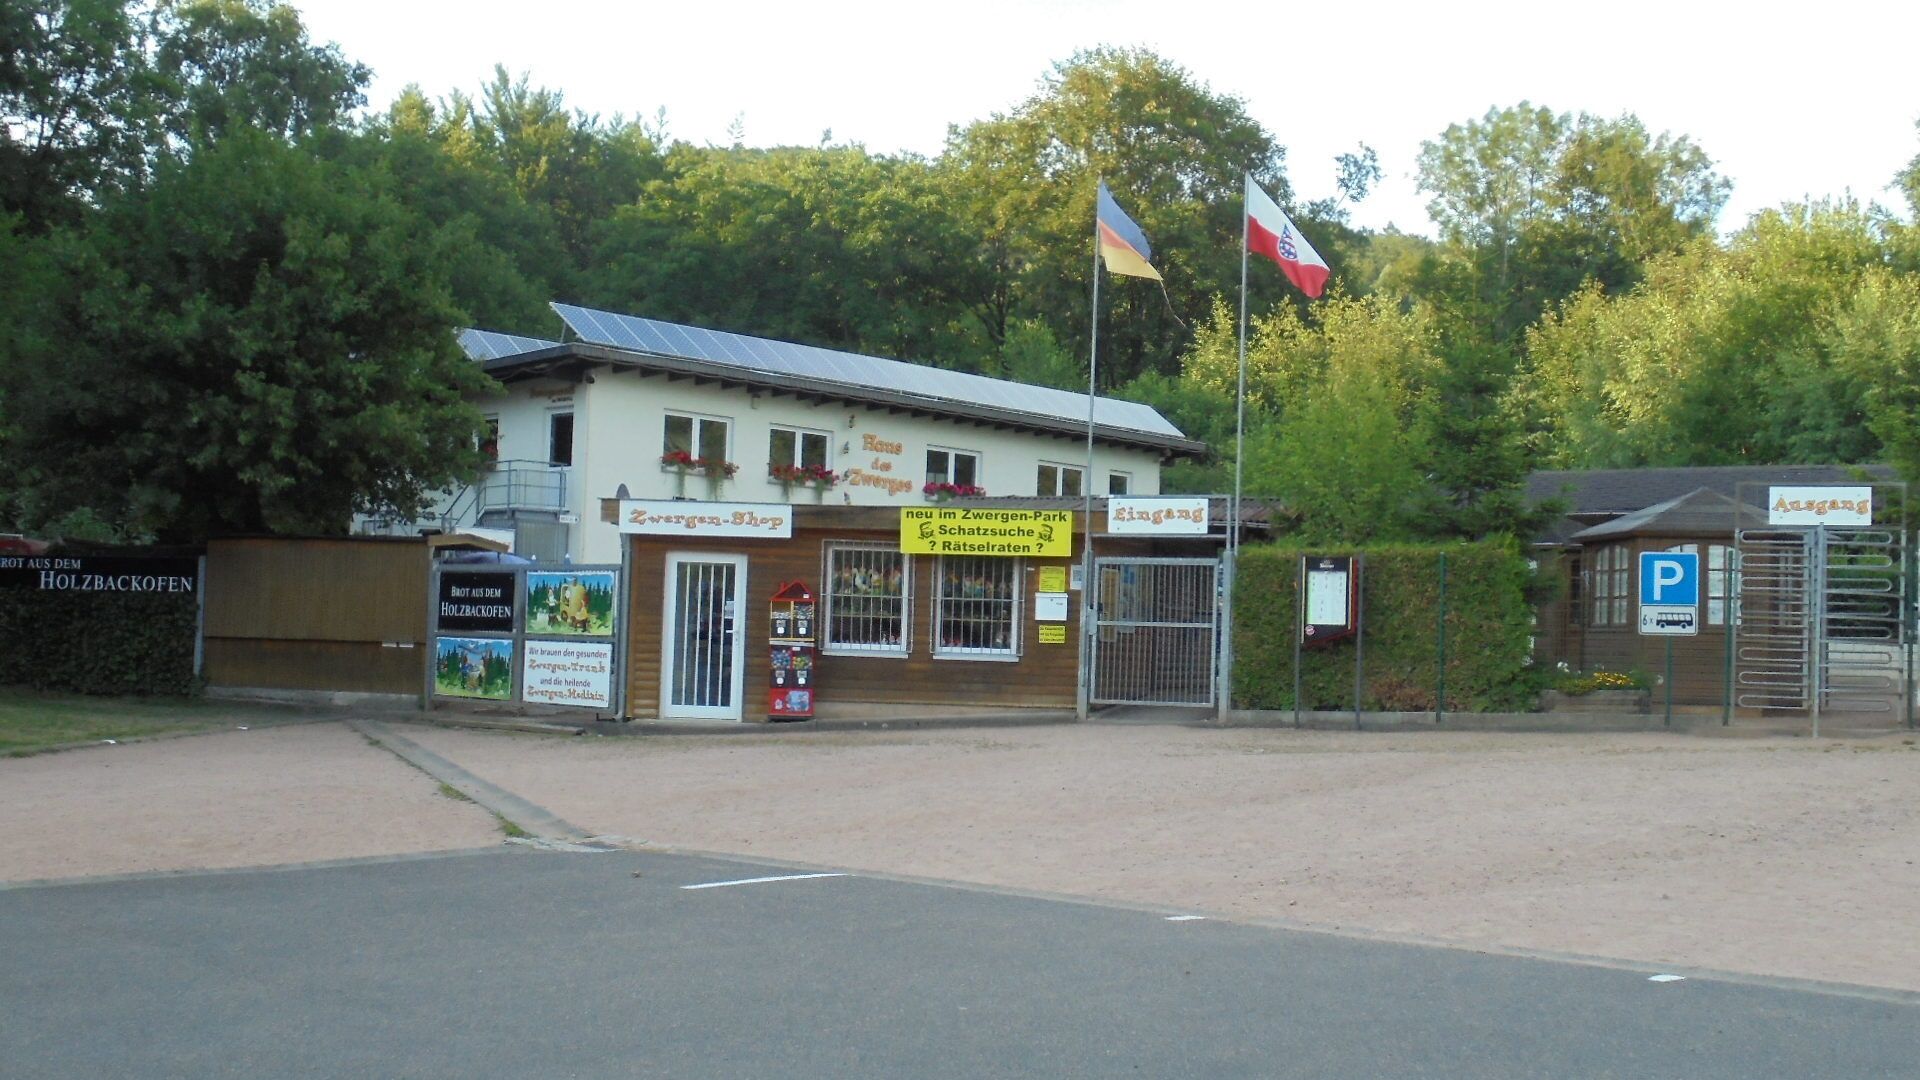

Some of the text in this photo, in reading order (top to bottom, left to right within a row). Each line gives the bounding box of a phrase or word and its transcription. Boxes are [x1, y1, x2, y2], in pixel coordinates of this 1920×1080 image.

[863, 433, 903, 455] Haus
[849, 468, 912, 496] Zwerges
[1772, 497, 1869, 515] Ausgang
[629, 508, 784, 530] Zwergen-Shop
[906, 508, 1067, 523] neu im Zwergen-Park
[1113, 506, 1204, 525] Eingang
[938, 524, 1035, 537] Schatzsuche
[929, 540, 1044, 553] ? Rätselraten ?
[0, 557, 81, 569] ROT AUS DEM
[1653, 560, 1684, 601] P
[1643, 614, 1648, 626] 6
[529, 647, 608, 660] Wir brauen den gesunden
[540, 677, 592, 688] und die heilende
